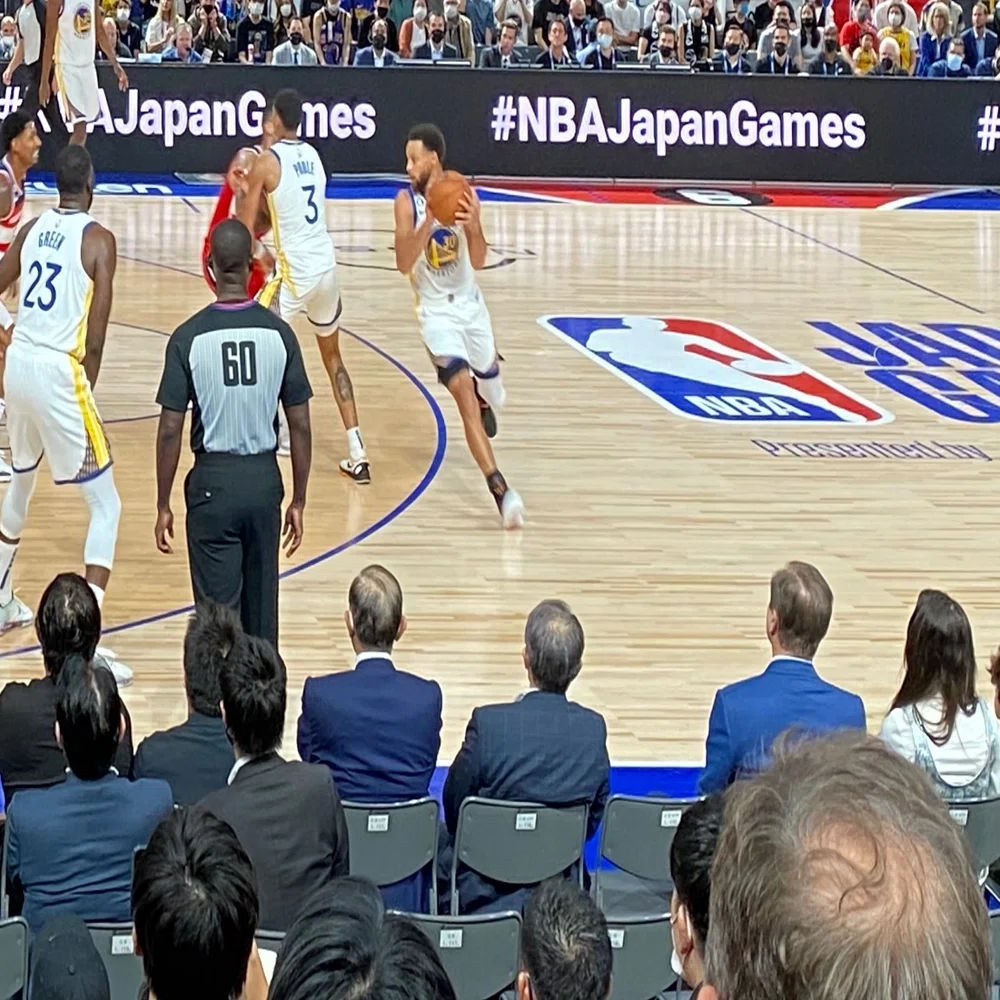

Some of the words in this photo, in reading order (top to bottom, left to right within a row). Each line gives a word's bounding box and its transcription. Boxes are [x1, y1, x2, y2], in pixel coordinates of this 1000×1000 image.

[491, 96, 866, 157] #NBAJapanGames
[301, 184, 318, 225] 3
[38, 232, 66, 251] GREEN
[23, 260, 63, 312] 23
[222, 340, 257, 387] 60
[685, 396, 810, 417] NBA
[750, 439, 946, 459] Presented
[930, 439, 992, 461] by
